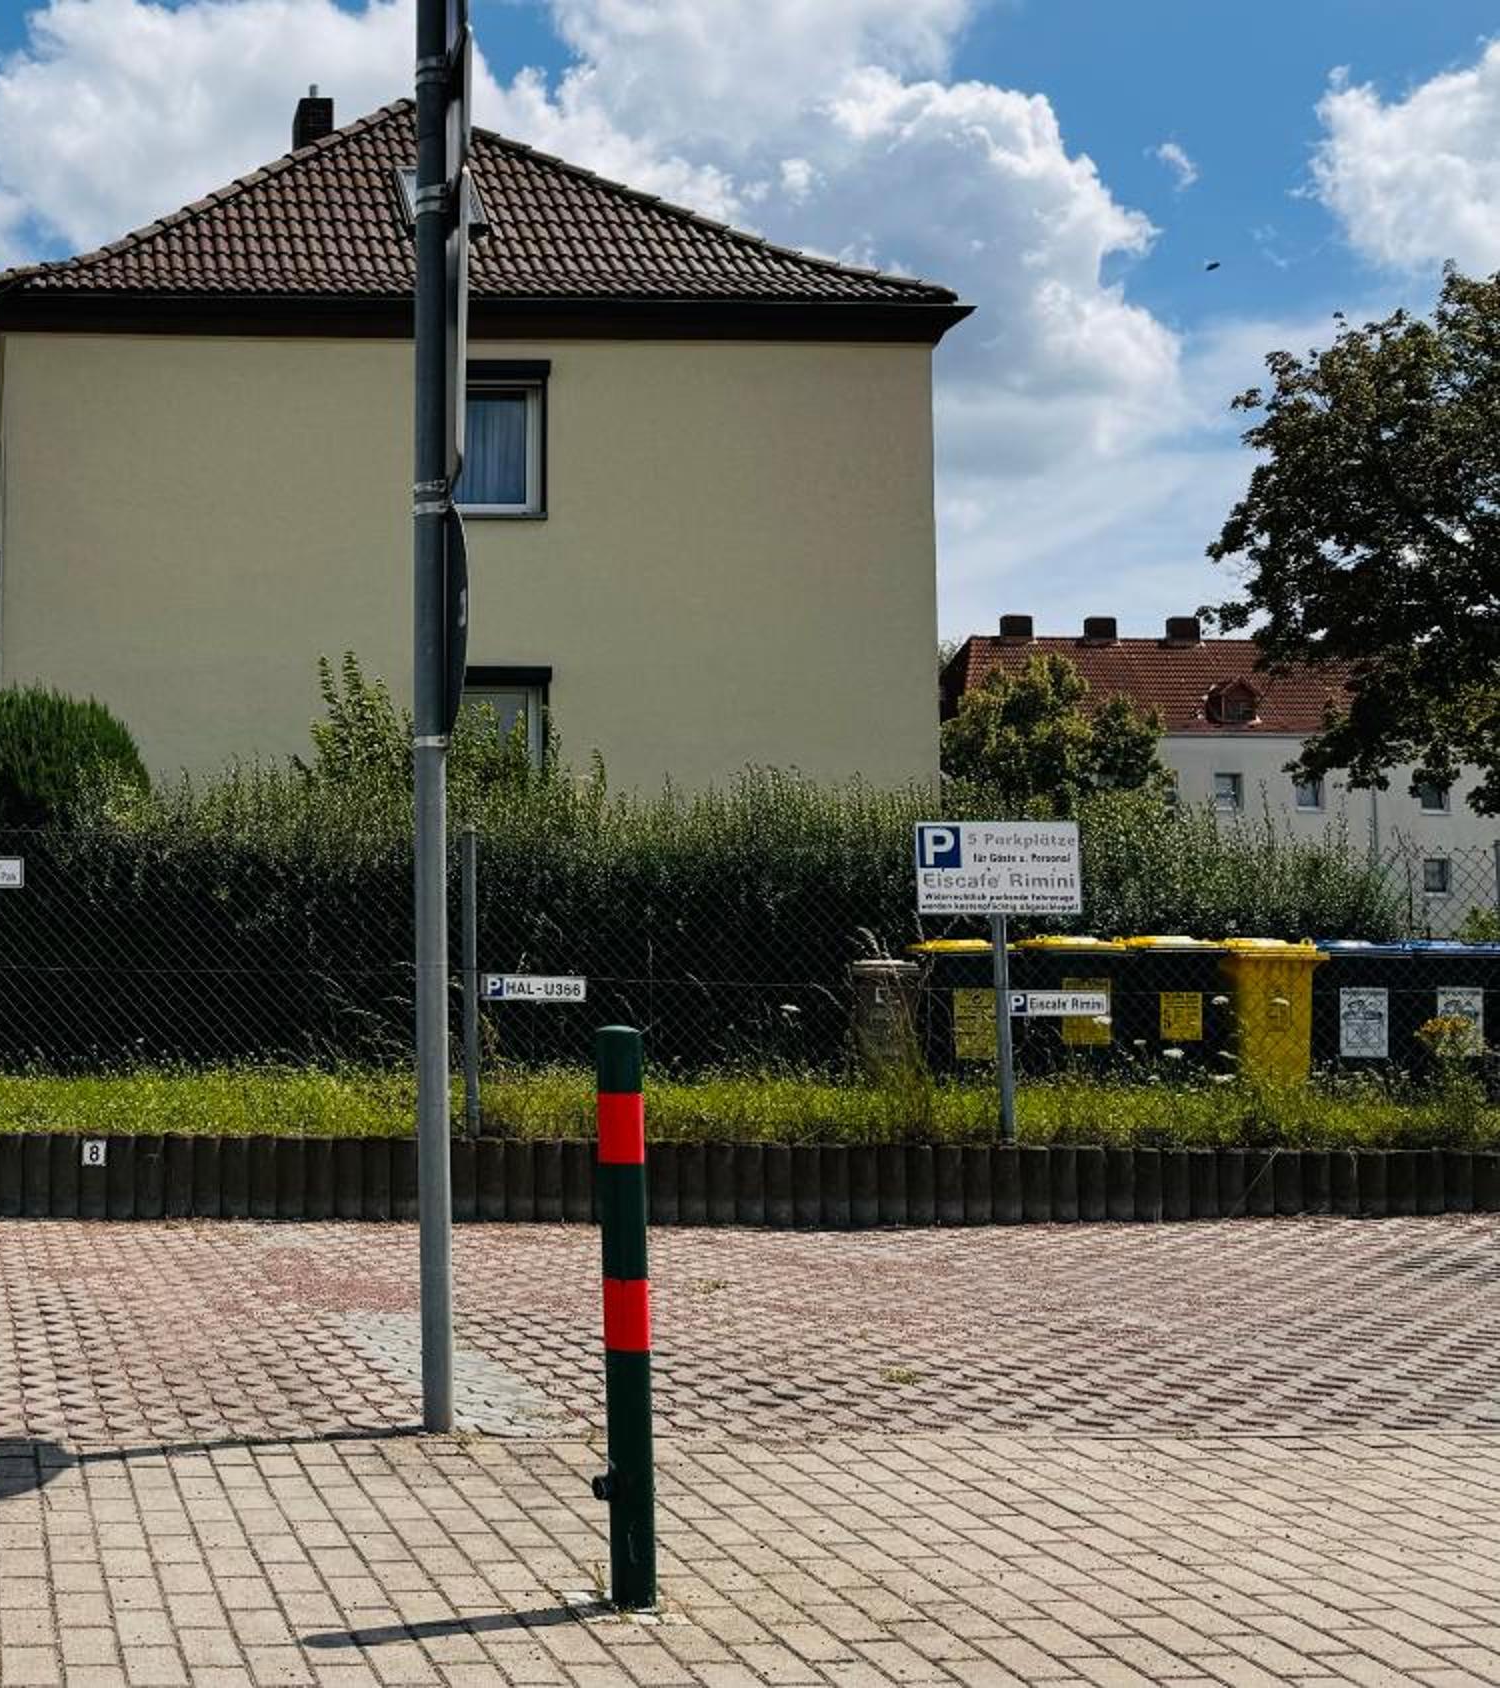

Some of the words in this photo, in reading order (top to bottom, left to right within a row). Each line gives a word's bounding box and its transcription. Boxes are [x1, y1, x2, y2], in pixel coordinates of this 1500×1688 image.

[923, 828, 955, 865] P
[967, 833, 977, 846] 5
[984, 833, 1076, 849] Parkplätze
[973, 853, 987, 863] für
[989, 853, 1017, 863] Gäste
[1031, 852, 1071, 863] Personal
[1009, 872, 1075, 889] Rimini
[487, 979, 501, 995] P
[505, 981, 581, 996] HAL-U366
[1011, 995, 1025, 1011] P
[1071, 997, 1104, 1011] Rimini
[89, 1145, 100, 1162] 8
